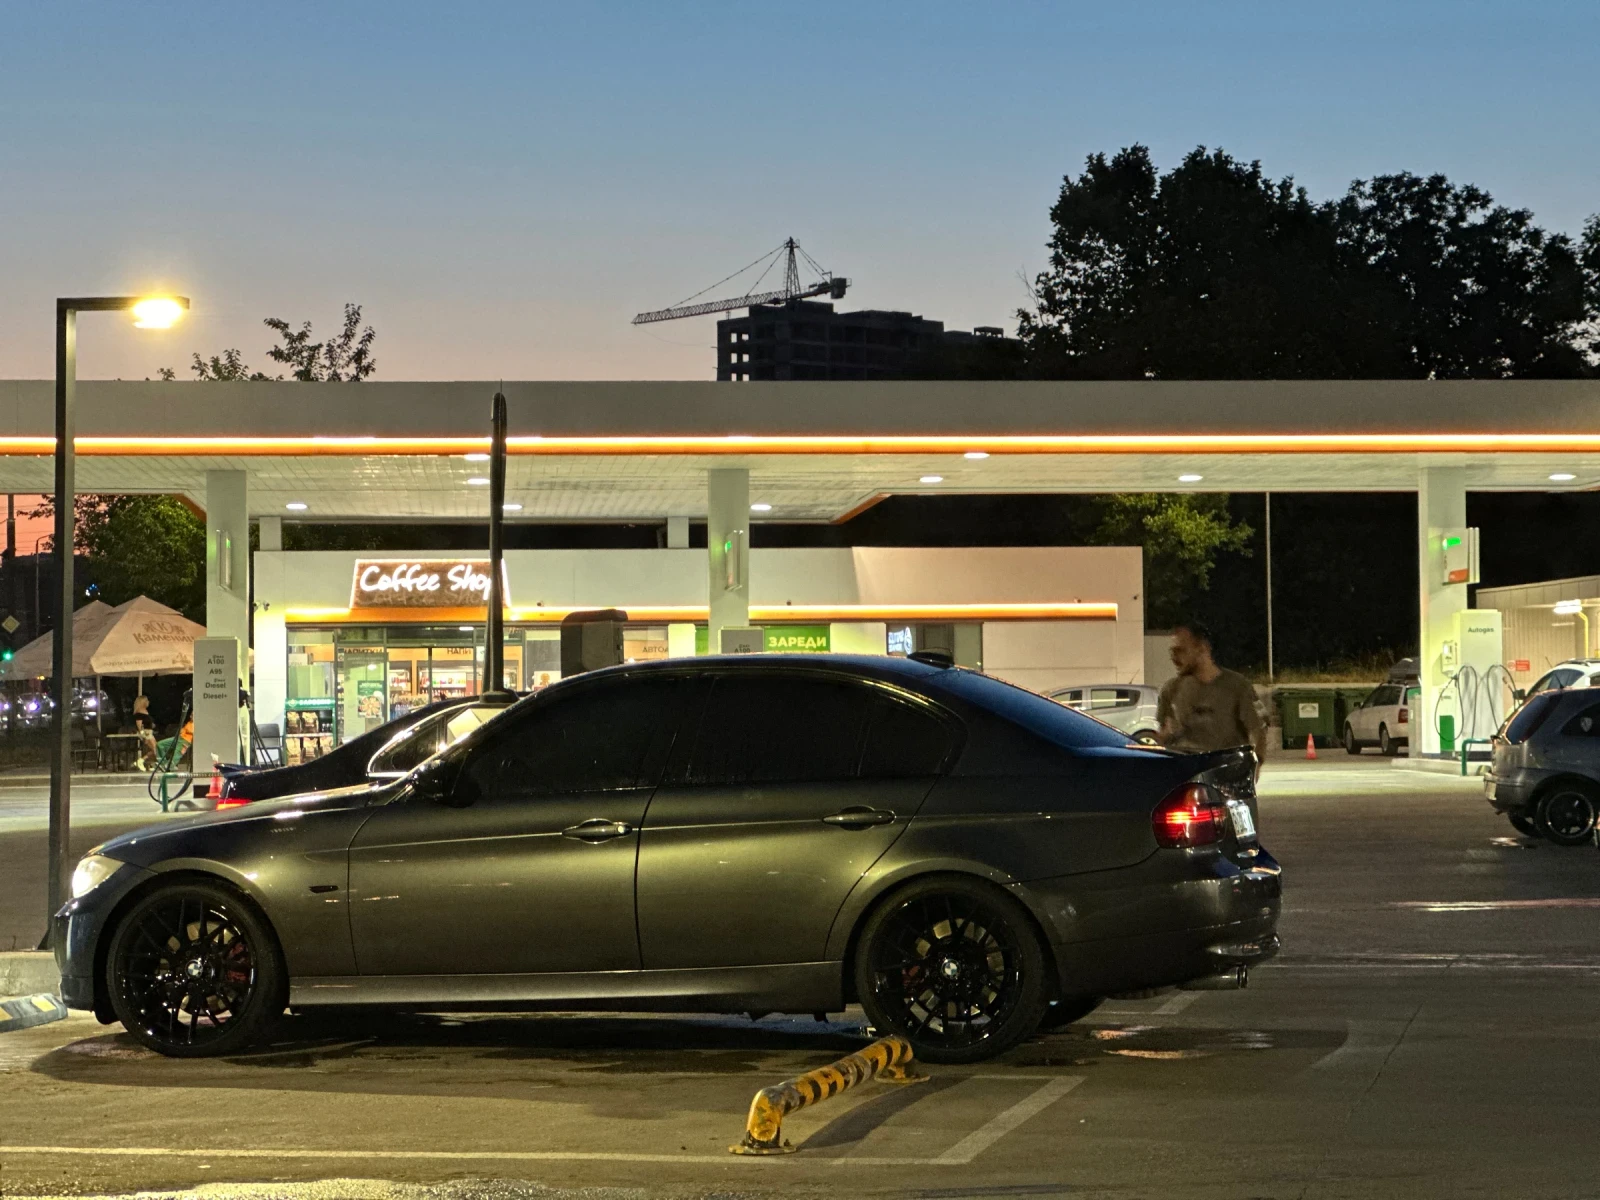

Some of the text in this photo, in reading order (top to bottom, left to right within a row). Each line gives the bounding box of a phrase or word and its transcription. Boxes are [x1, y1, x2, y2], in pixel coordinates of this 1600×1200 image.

[360, 564, 440, 592] Coffee
[1467, 626, 1494, 634] Autogas
[768, 636, 827, 648] ЗАРЕДИ
